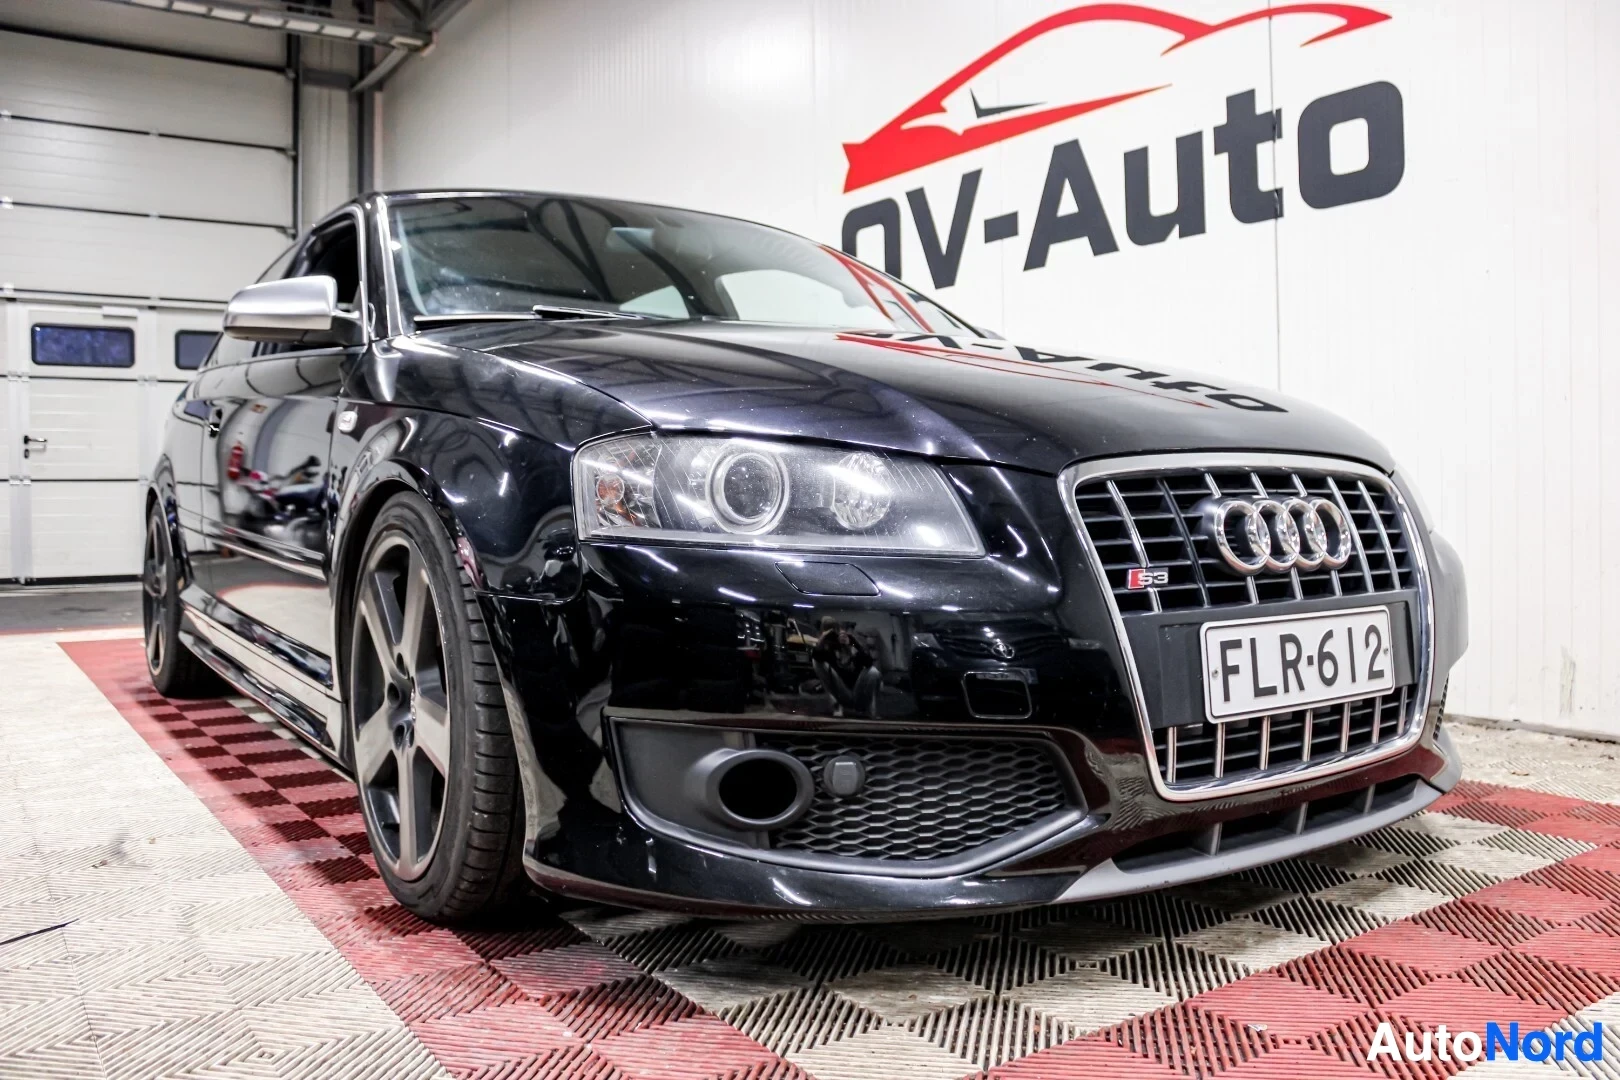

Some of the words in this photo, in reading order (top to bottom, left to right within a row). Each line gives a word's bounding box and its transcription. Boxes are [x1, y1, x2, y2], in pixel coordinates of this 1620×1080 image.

[841, 80, 1405, 290] OV-Auto
[1136, 570, 1169, 587] S3
[1219, 623, 1385, 702] FLR-612
